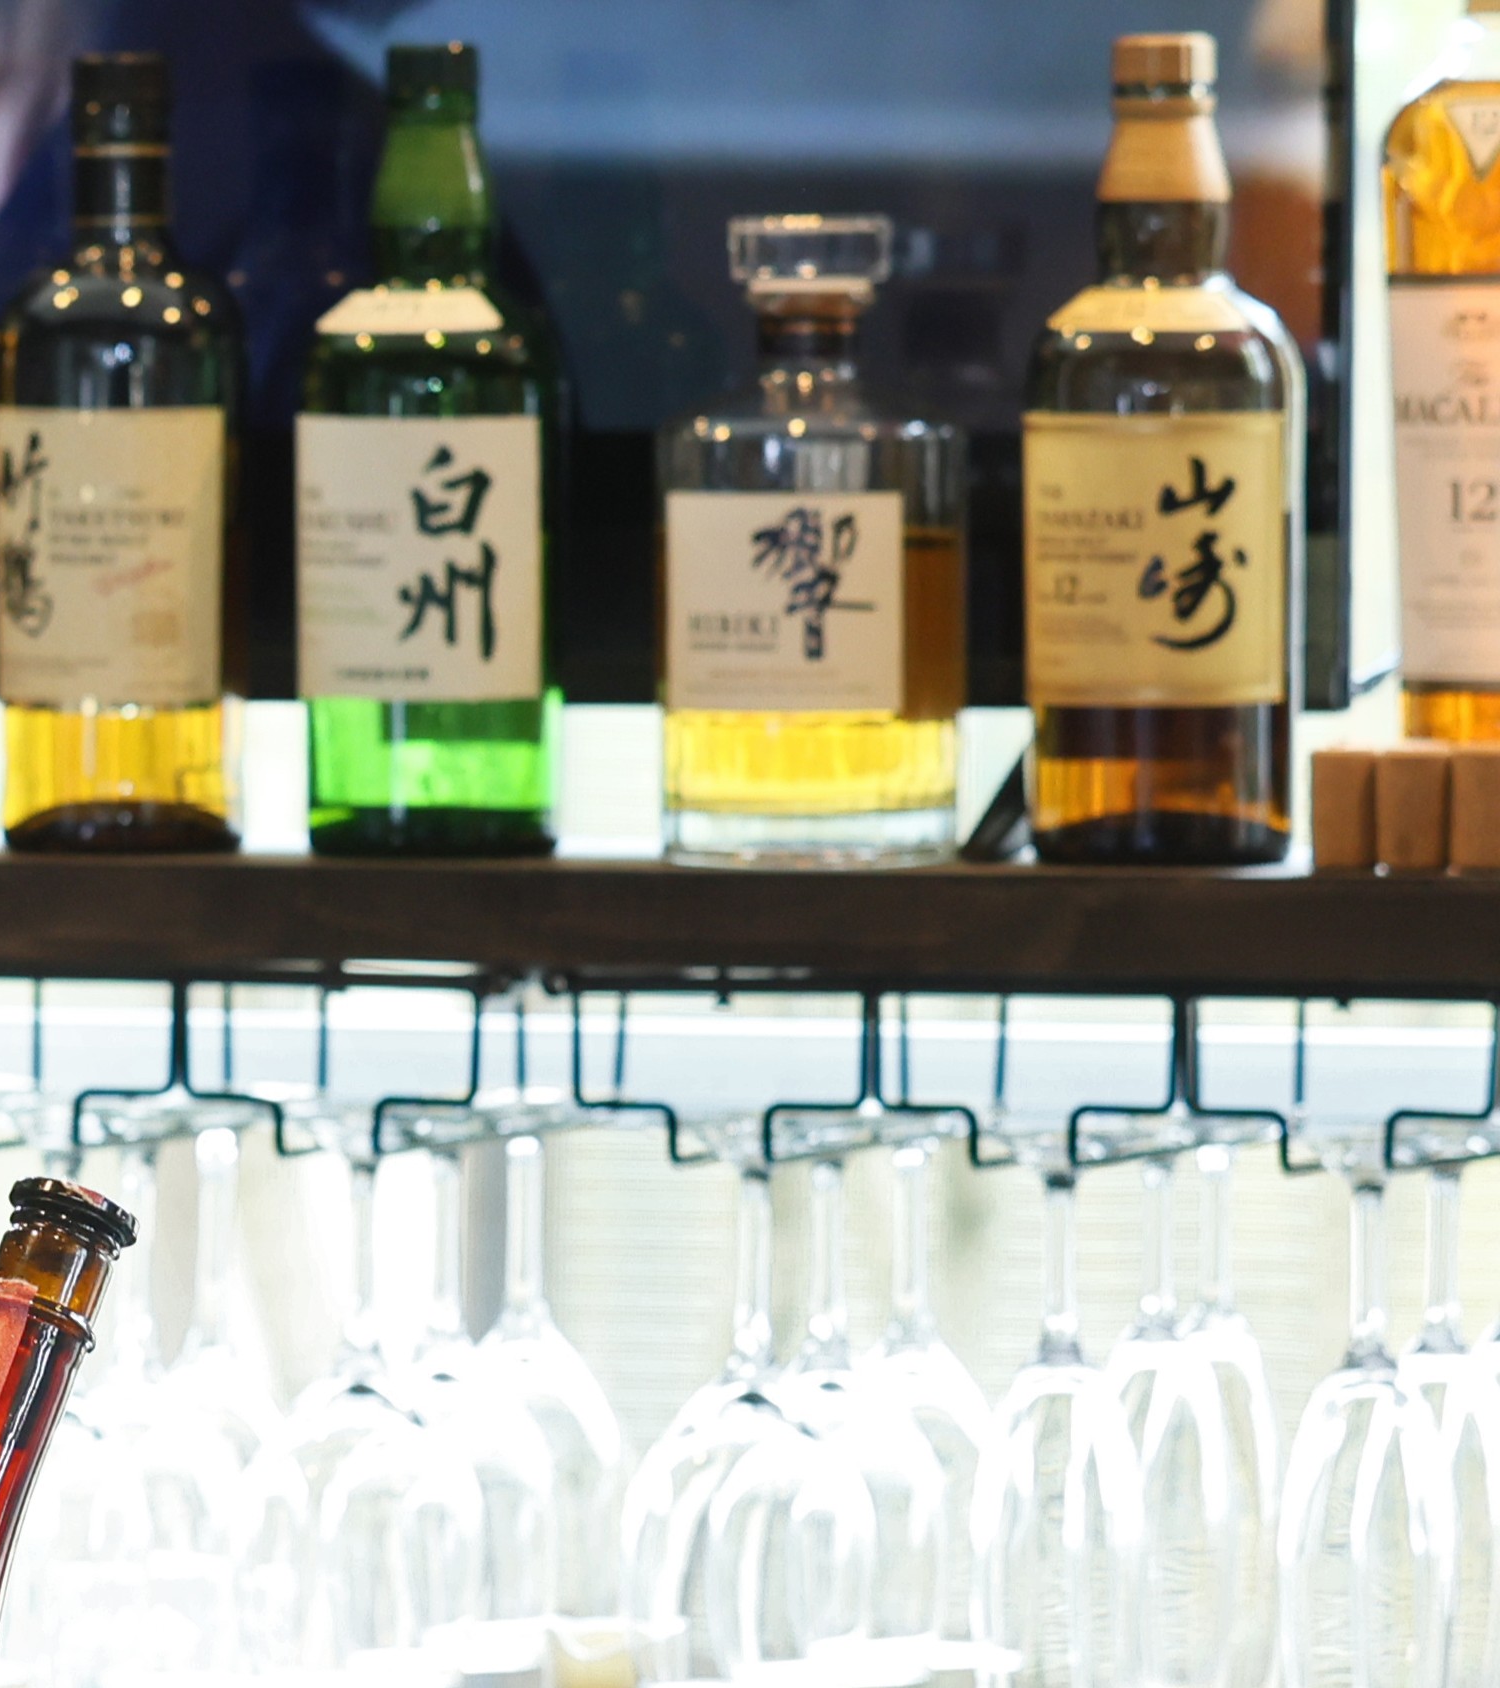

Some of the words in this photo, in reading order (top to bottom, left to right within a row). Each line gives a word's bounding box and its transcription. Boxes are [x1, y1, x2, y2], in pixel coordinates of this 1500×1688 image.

[398, 445, 498, 661] 白州
[752, 508, 876, 662] 響
[1138, 456, 1248, 652] 山崎
